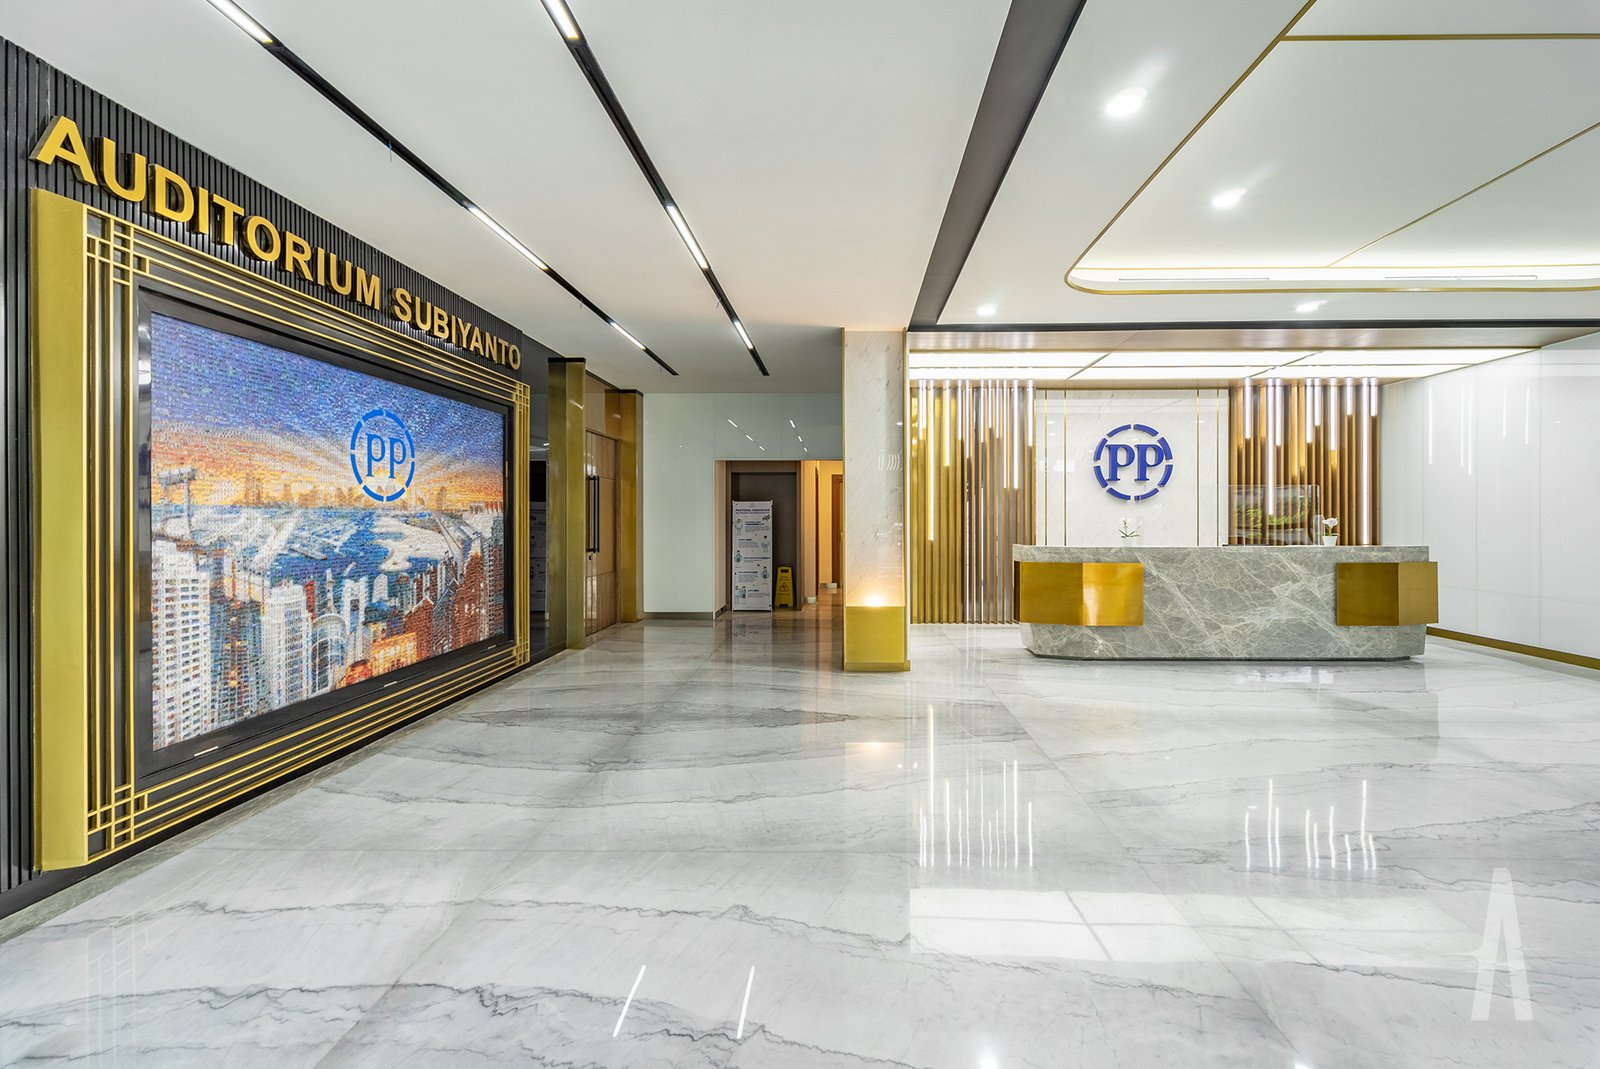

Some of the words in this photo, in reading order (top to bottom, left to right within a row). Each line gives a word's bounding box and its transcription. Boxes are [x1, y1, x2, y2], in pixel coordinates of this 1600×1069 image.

[30, 115, 382, 311] AUDITORIUM
[391, 286, 523, 370] SUBIYANTO
[1105, 443, 1165, 482] PP
